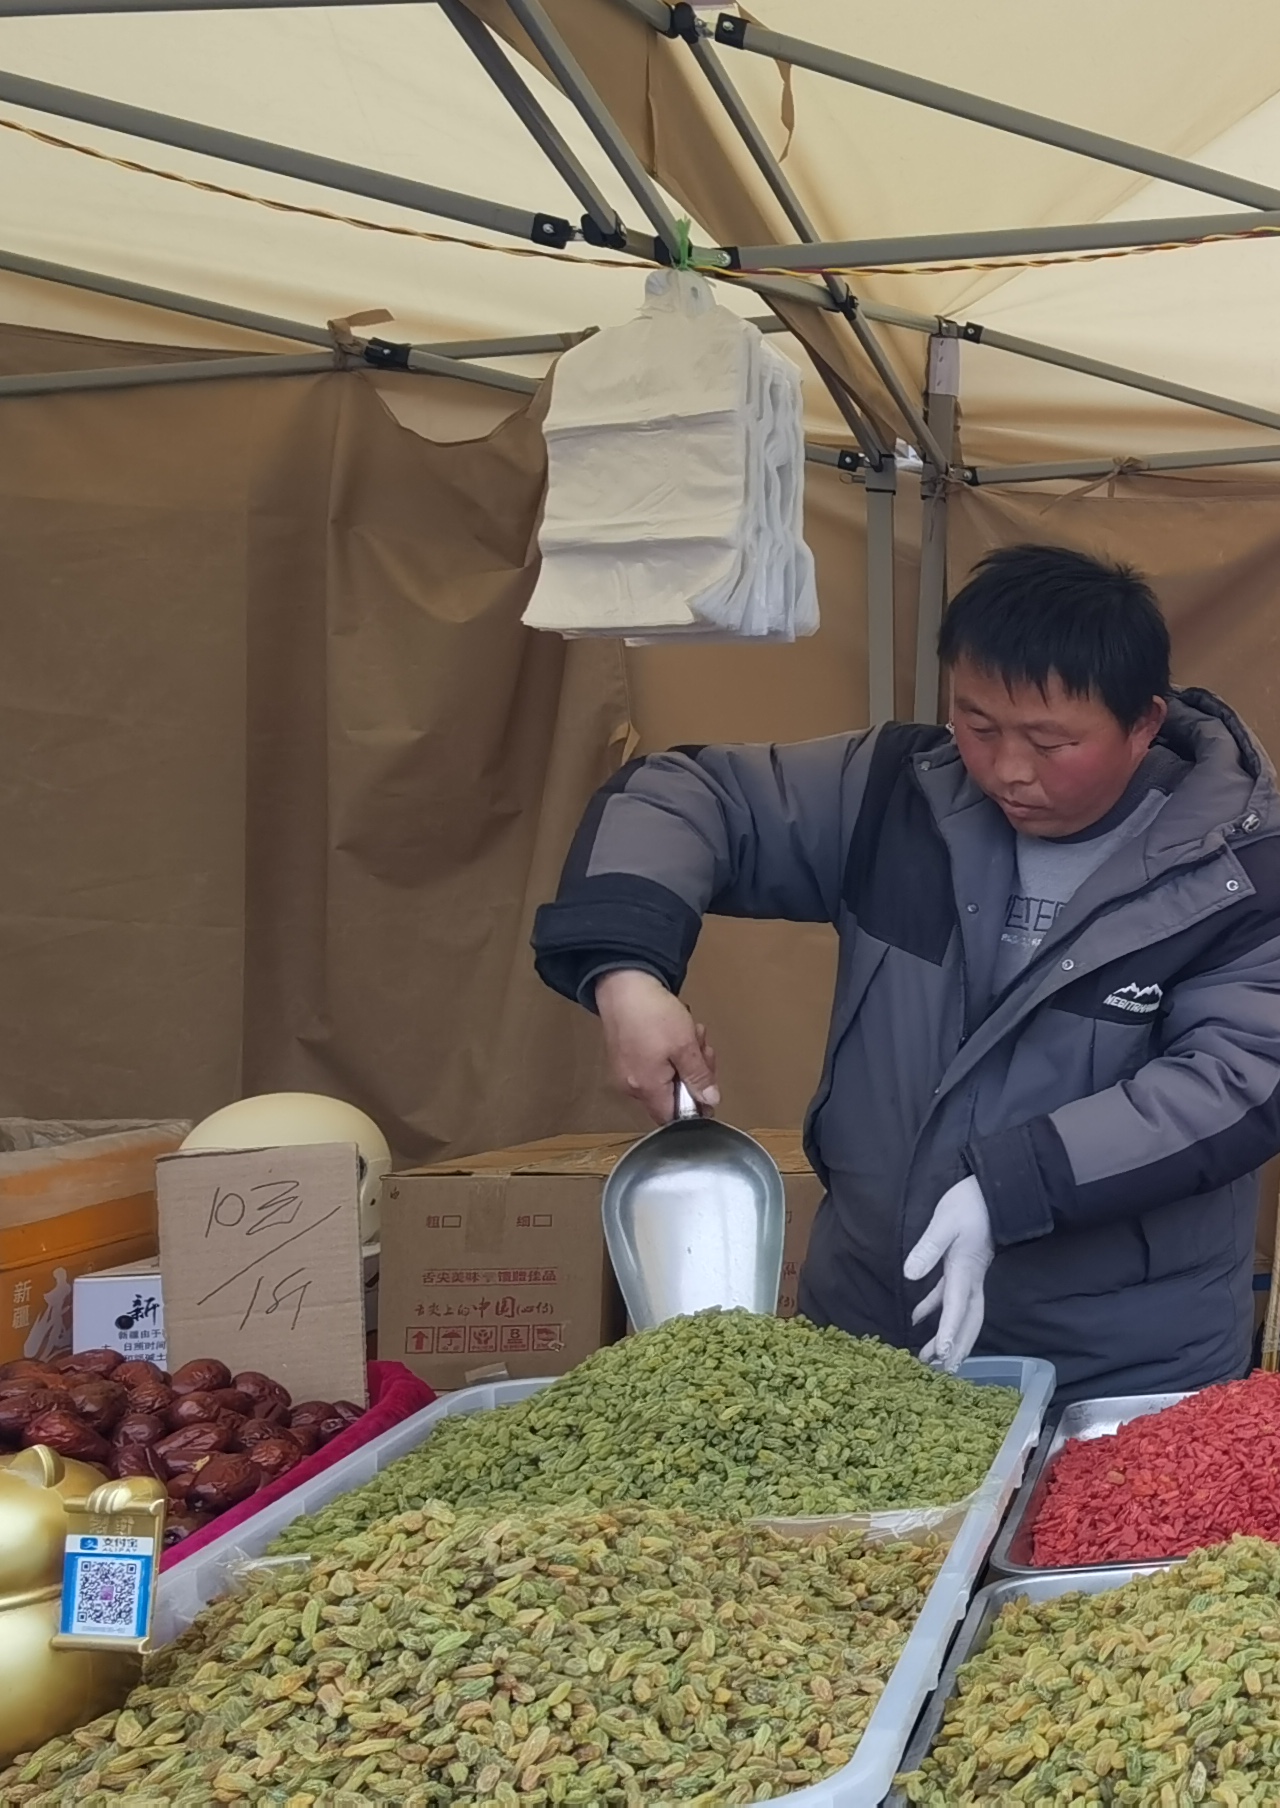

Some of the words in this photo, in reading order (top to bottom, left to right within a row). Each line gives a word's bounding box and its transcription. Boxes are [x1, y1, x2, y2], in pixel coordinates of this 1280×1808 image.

[205, 1180, 303, 1239] 10元
[426, 1215, 441, 1229] 粗
[516, 1215, 531, 1228] 细
[422, 1270, 480, 1285] 舌尖美味
[497, 1269, 557, 1284] 馈赠佳品
[12, 1279, 33, 1330] 新疆
[239, 1267, 312, 1331] 1斤
[118, 1328, 167, 1341] 新疆由于
[102, 1537, 138, 1549] 支付宝
